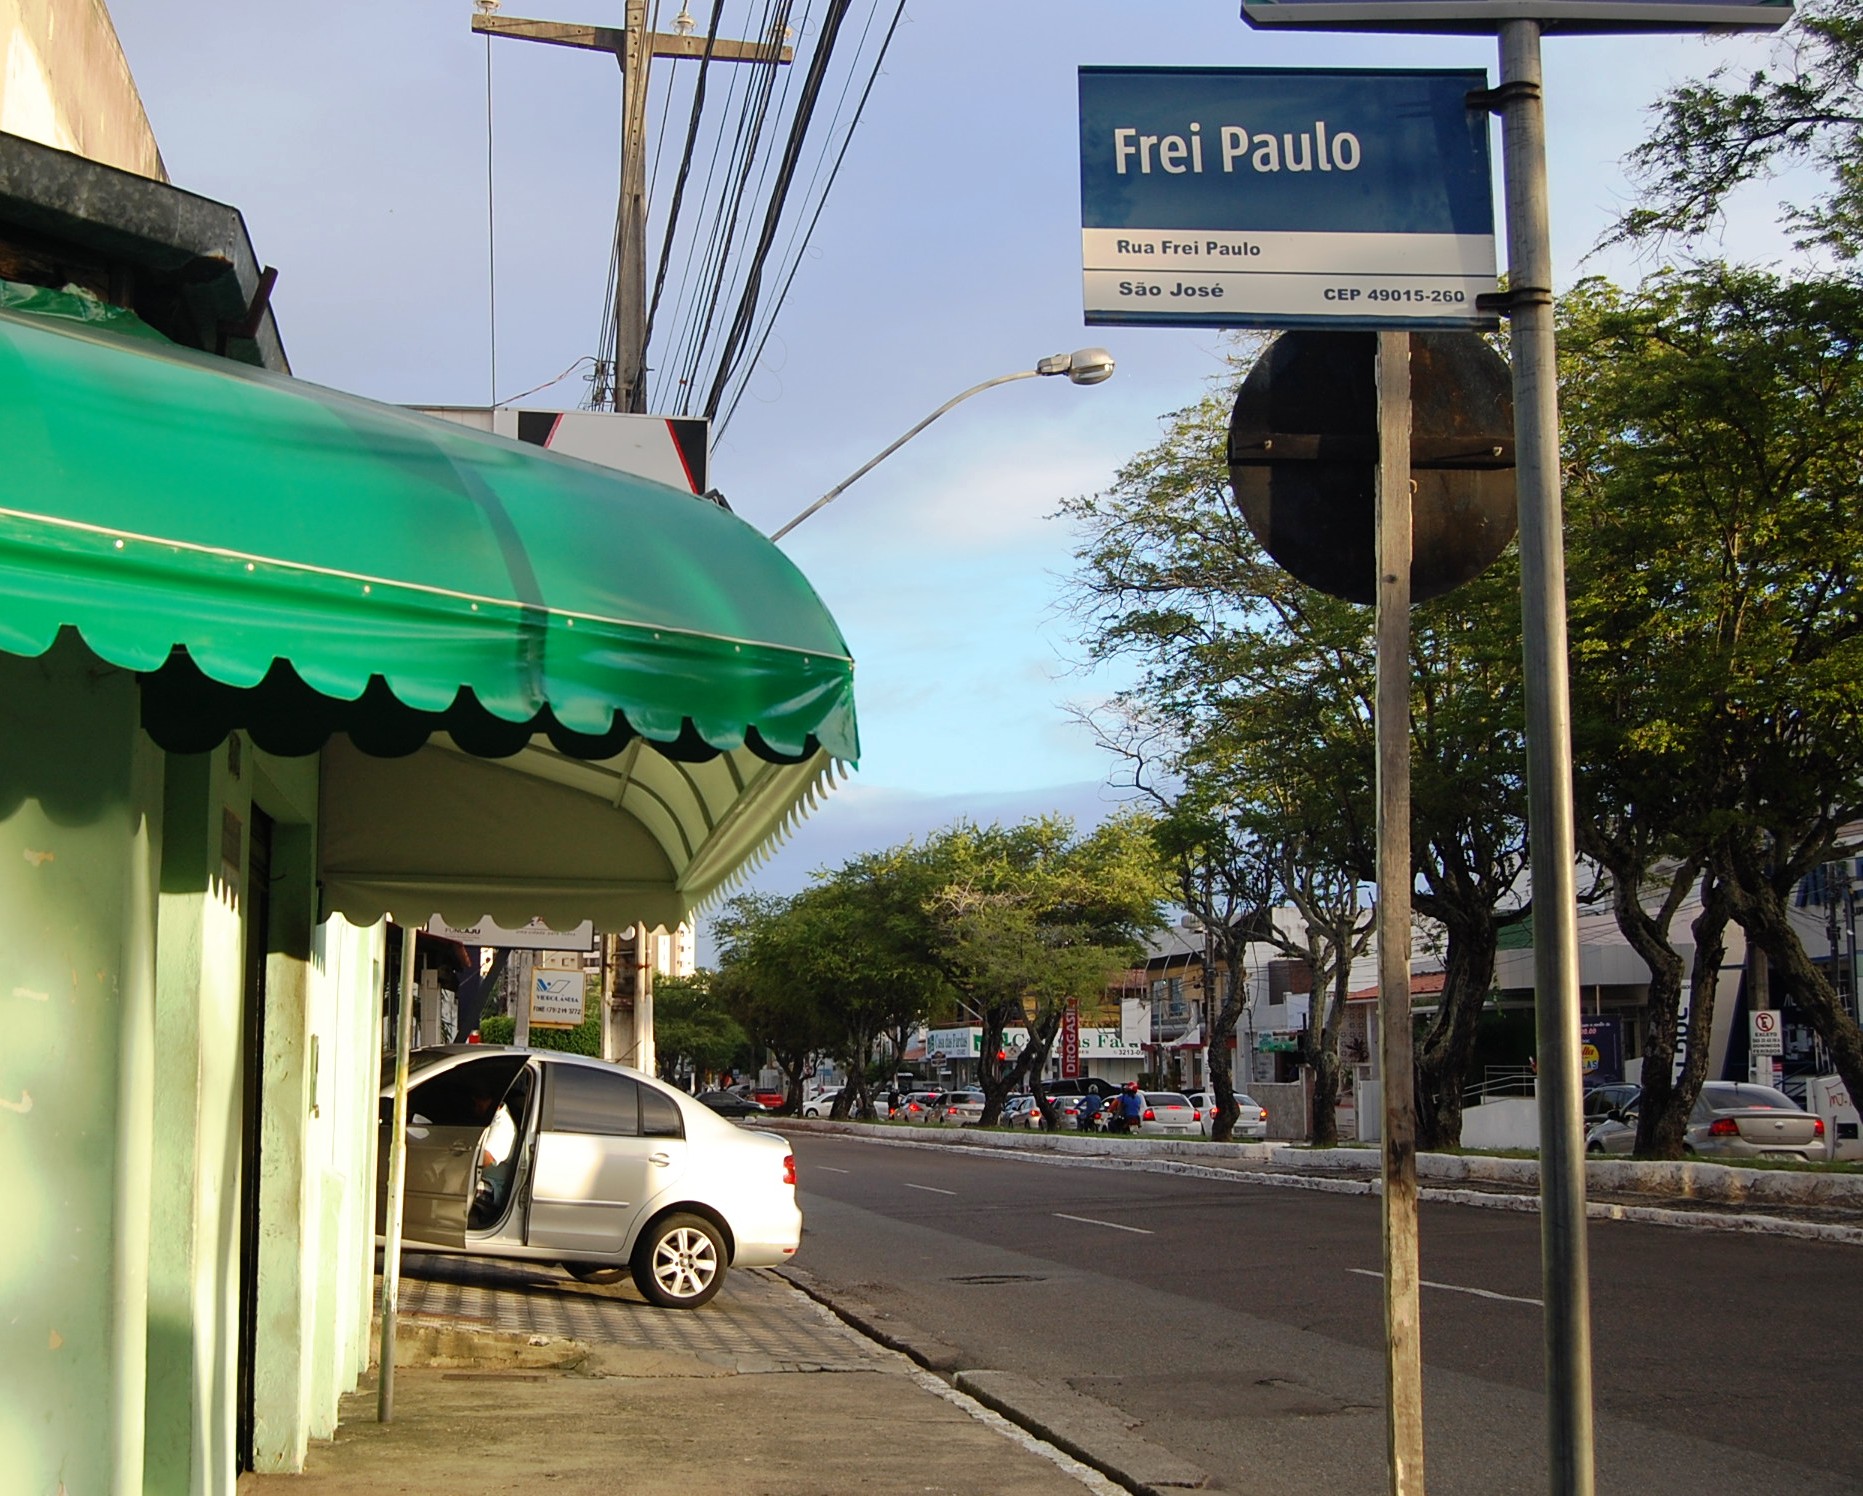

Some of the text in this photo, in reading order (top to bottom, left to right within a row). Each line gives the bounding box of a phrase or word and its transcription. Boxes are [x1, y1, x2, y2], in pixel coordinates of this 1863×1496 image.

[1114, 121, 1361, 174] Frei Paulo
[1117, 239, 1261, 256] Rua Frei Paulo
[1119, 281, 1224, 297] São José
[1323, 288, 1465, 302] CEP 49015-260
